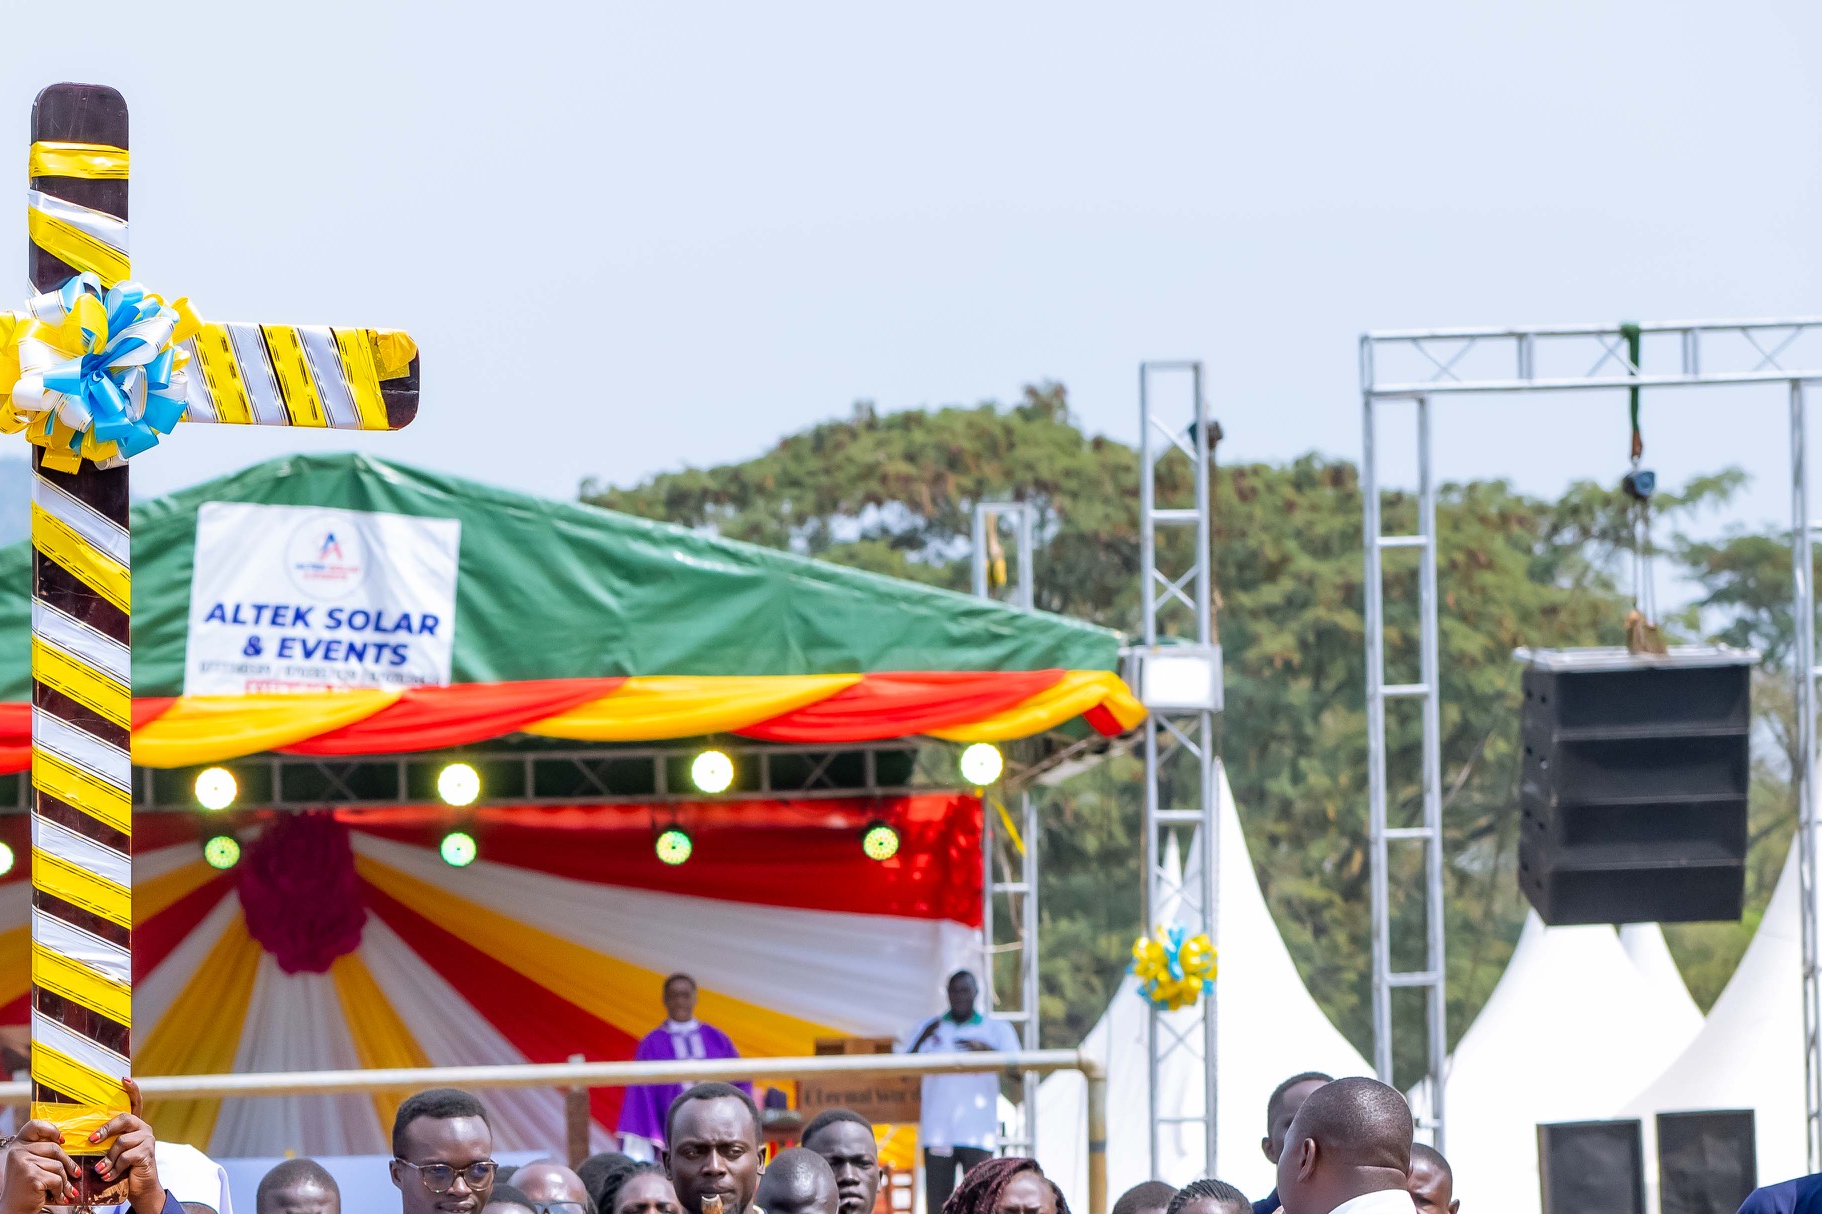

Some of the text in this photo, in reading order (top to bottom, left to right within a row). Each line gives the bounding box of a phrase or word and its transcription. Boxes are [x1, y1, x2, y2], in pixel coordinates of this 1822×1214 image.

[205, 603, 439, 636] ALTEK SOLAR
[243, 635, 409, 667] & EVENTS
